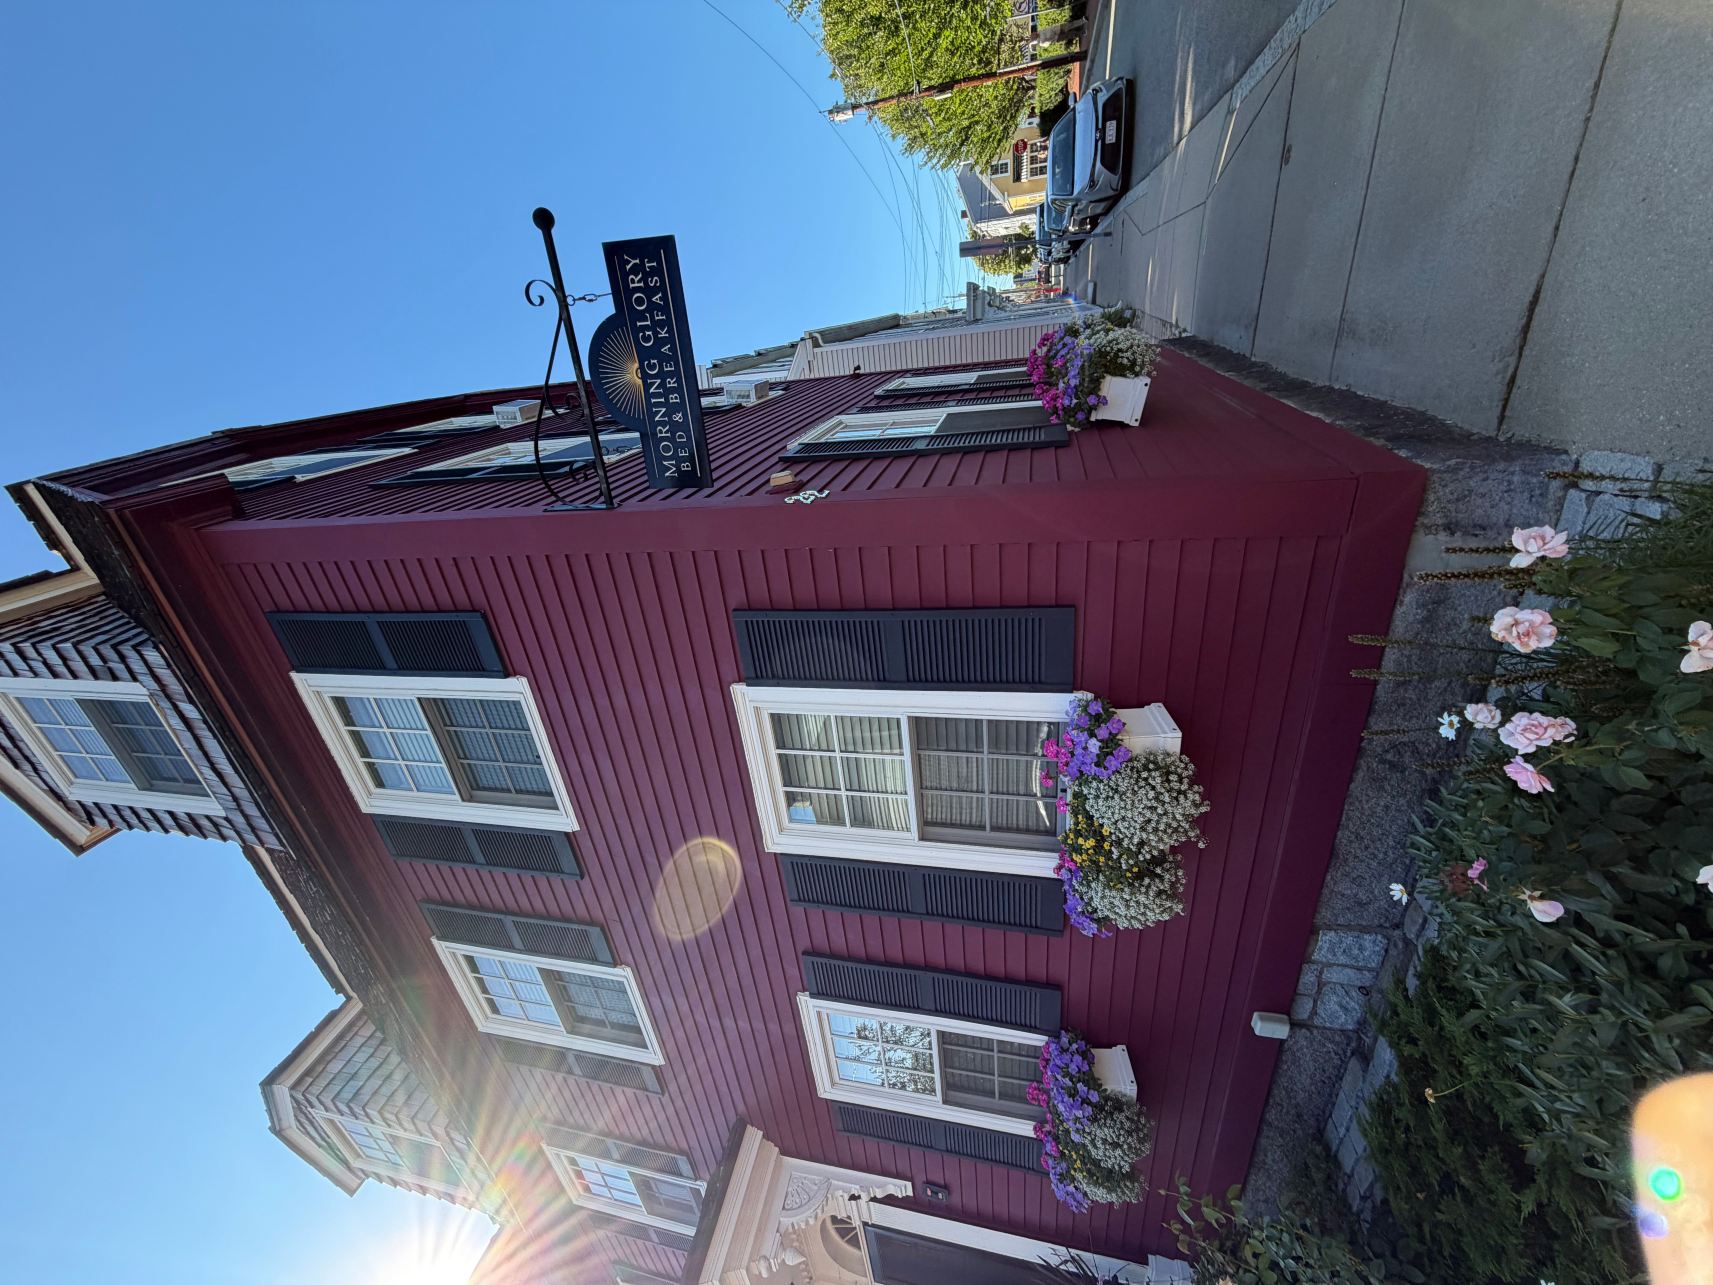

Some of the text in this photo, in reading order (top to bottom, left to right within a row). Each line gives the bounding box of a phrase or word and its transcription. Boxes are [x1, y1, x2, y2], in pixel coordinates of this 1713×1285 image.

[624, 254, 678, 477] MORNING GLORY
[645, 258, 691, 471] BED & BREAKFAST
[784, 490, 830, 504] 22
